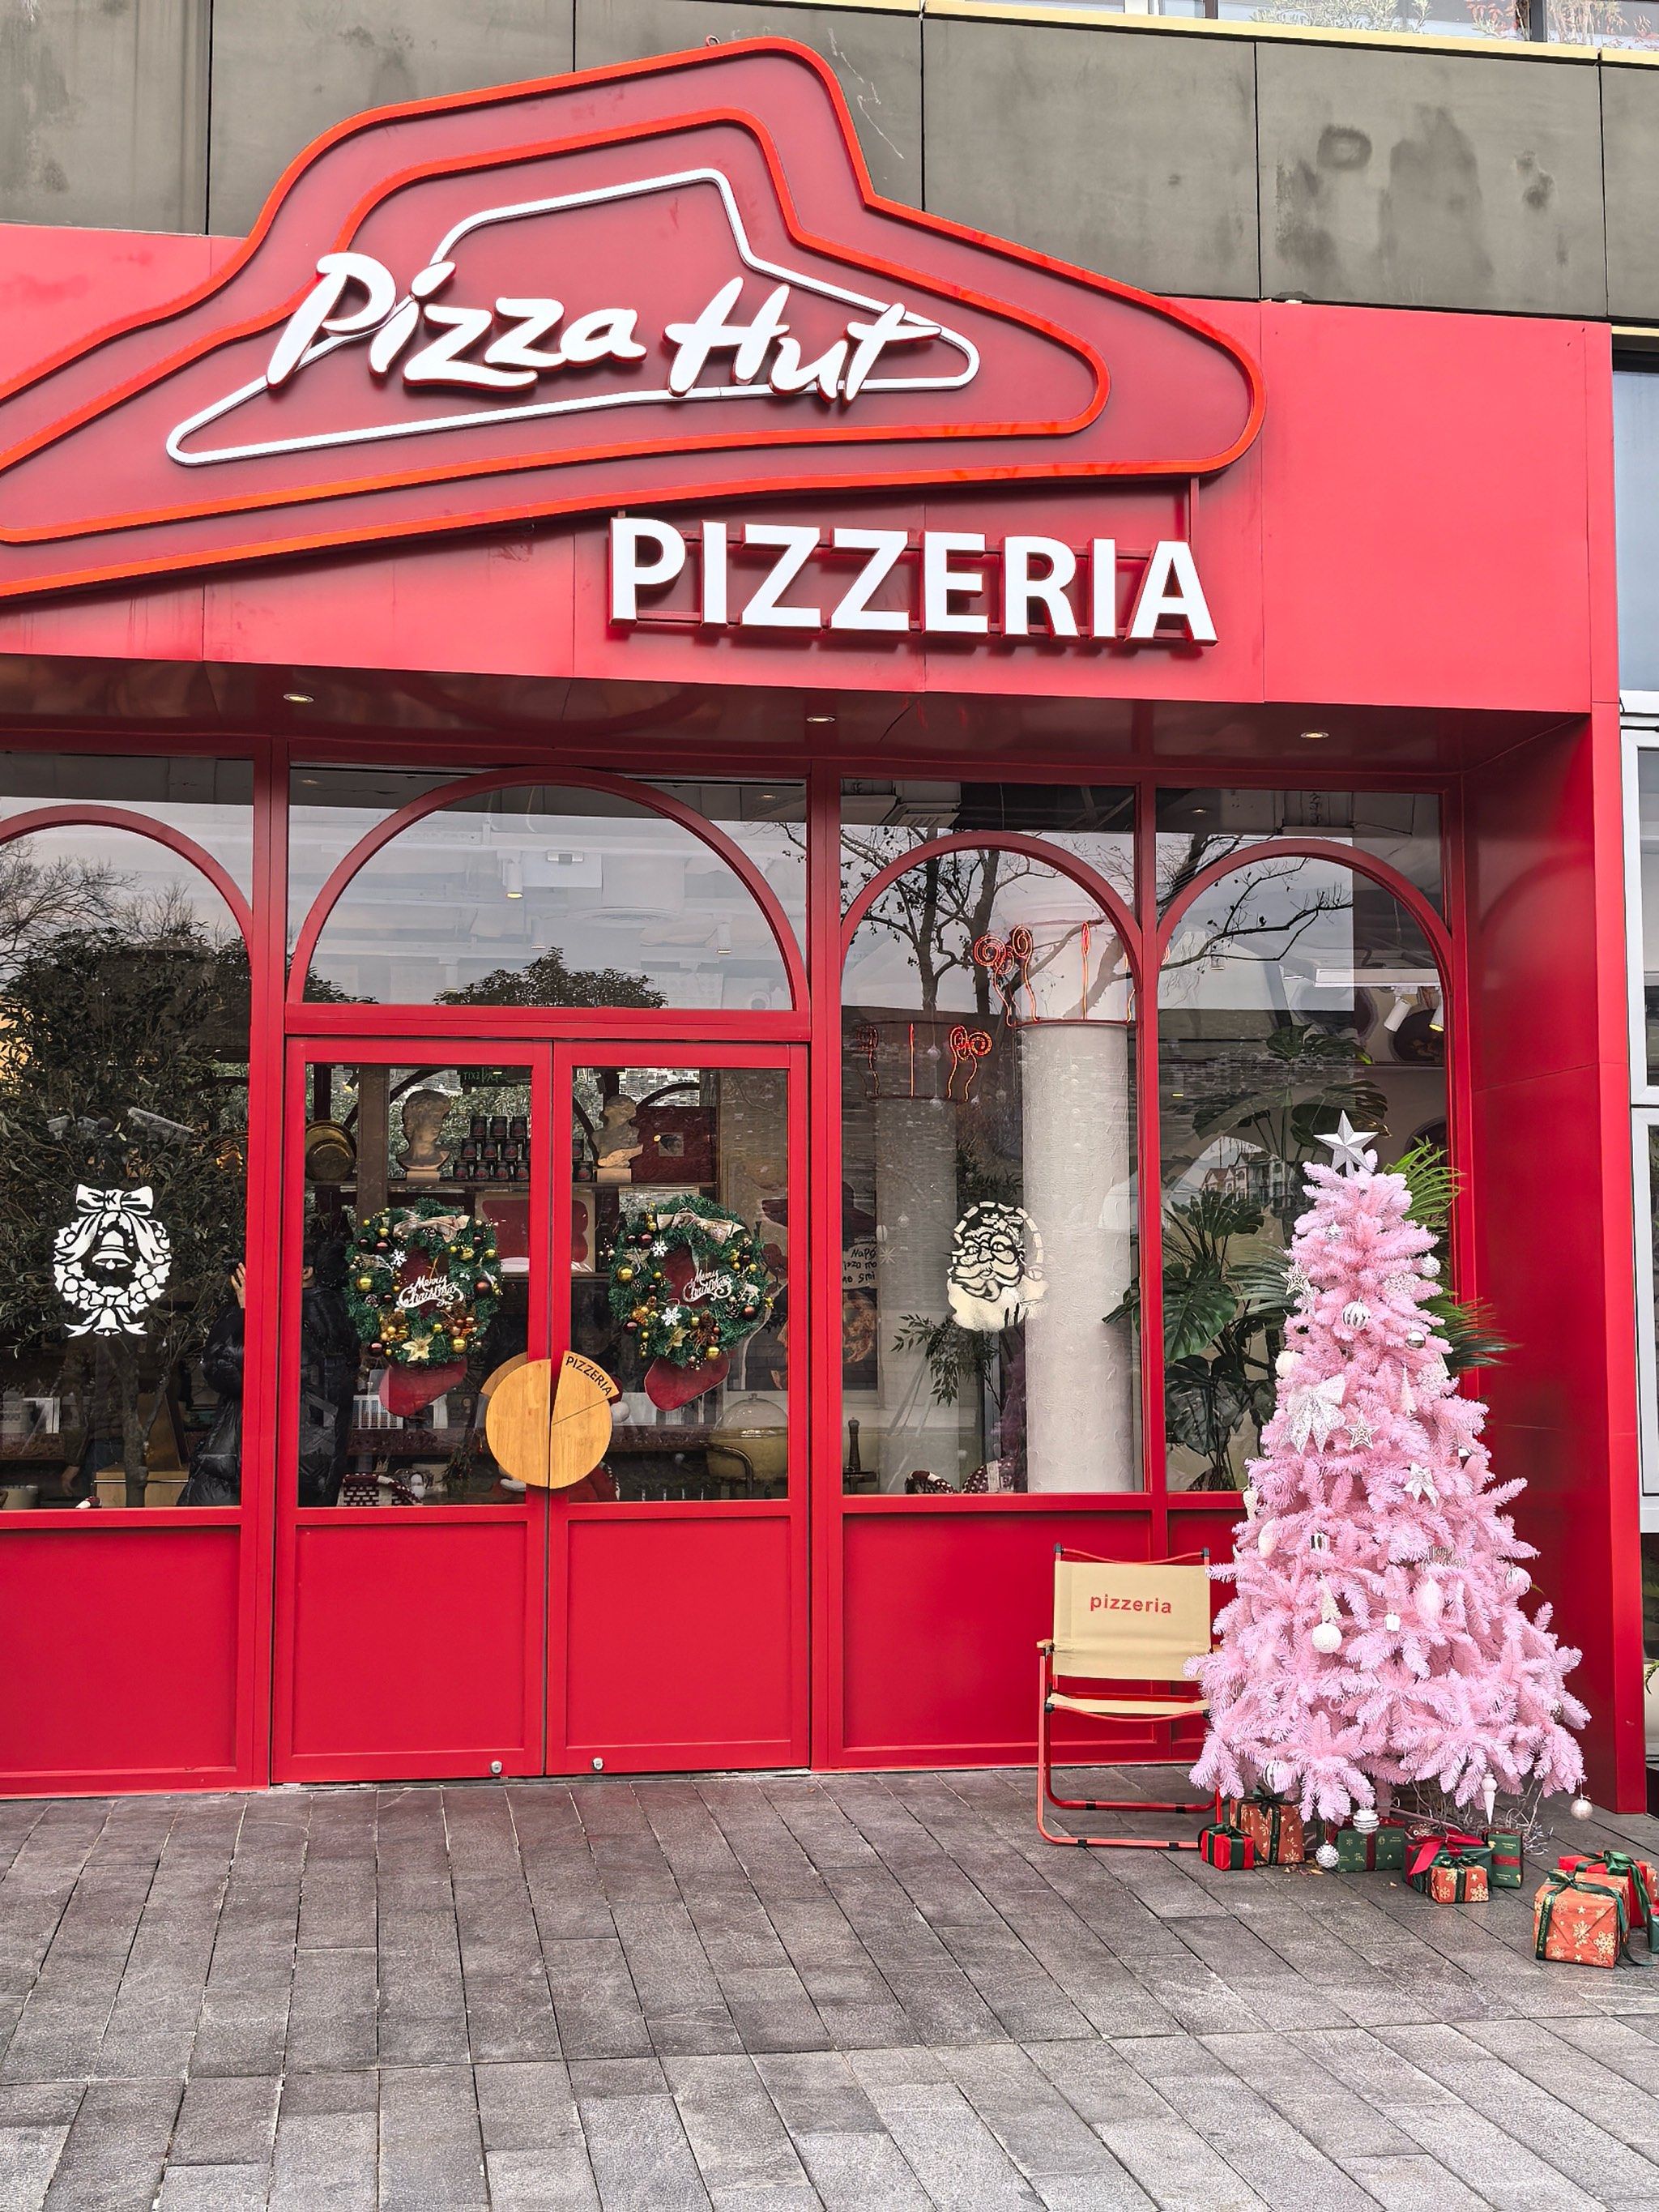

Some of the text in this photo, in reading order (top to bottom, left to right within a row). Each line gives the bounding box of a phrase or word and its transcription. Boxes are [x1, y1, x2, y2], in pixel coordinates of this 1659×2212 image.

[266, 252, 943, 403] Pizza Hut
[610, 517, 1218, 645] PIZZERIA
[565, 1356, 612, 1396] PIZZERIA
[1090, 1593, 1172, 1614] pizzeria
